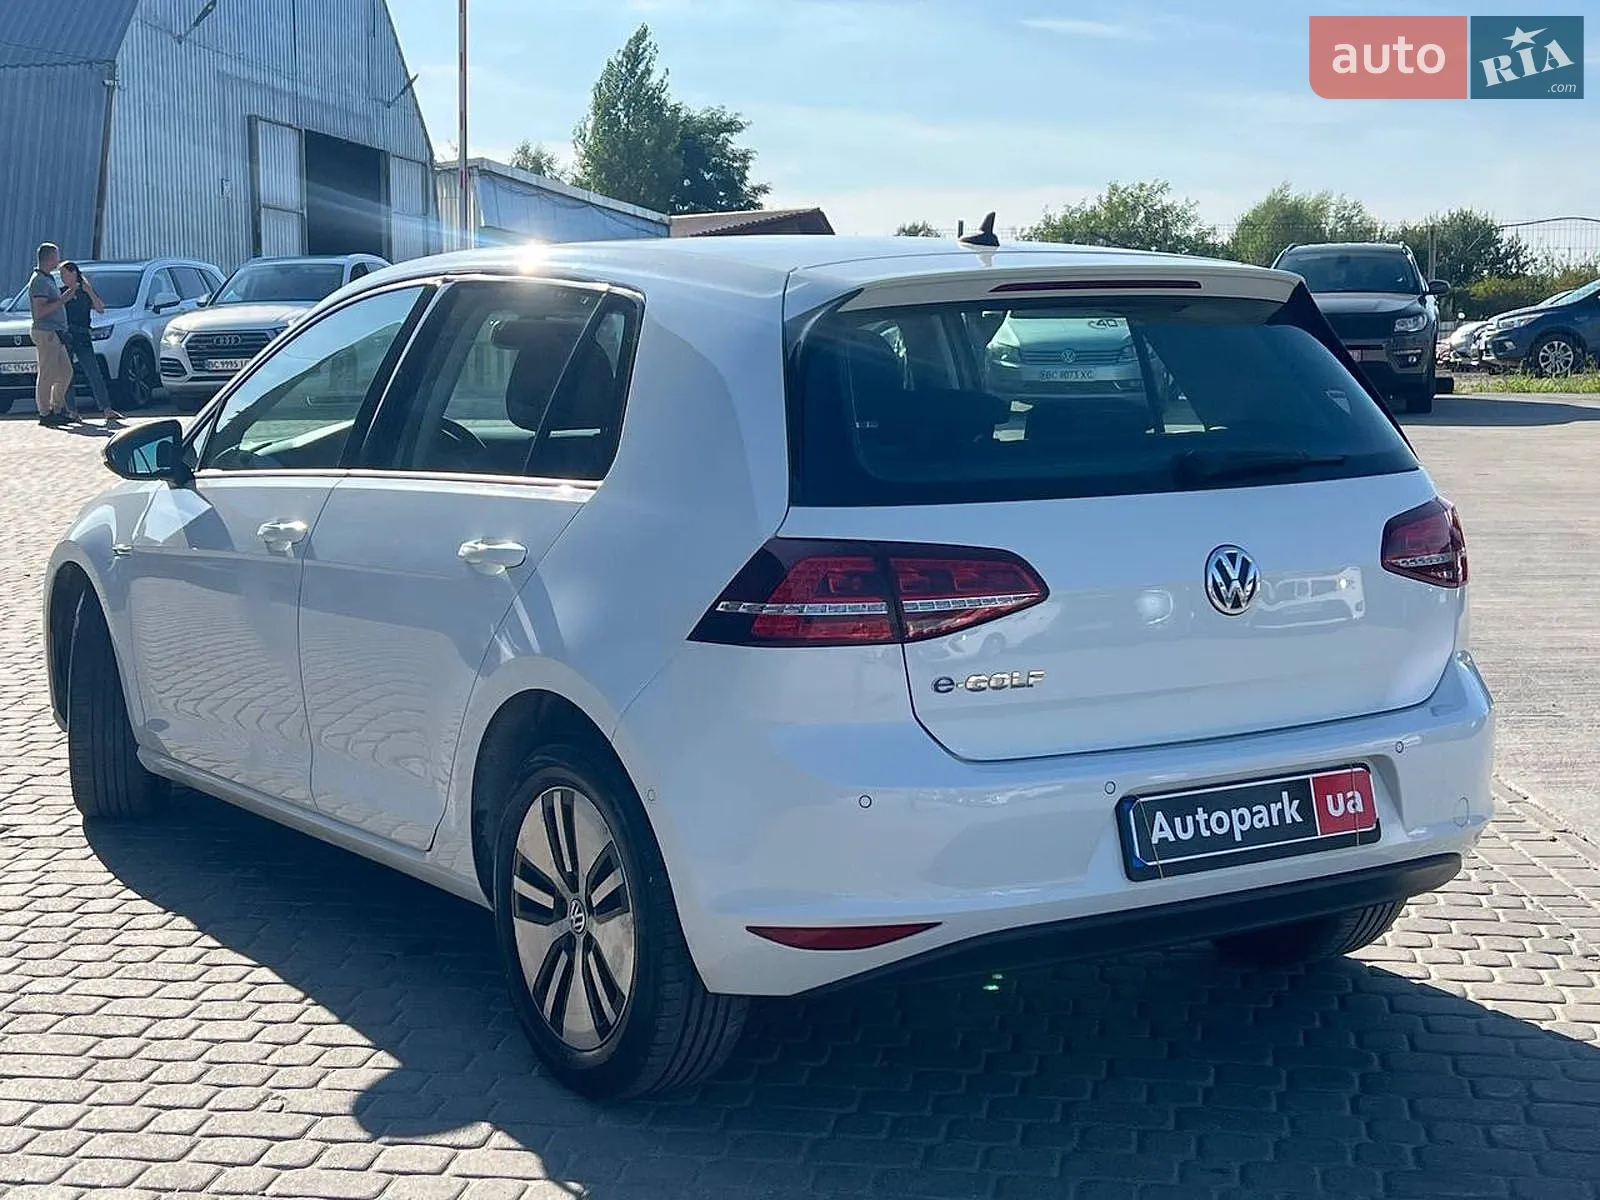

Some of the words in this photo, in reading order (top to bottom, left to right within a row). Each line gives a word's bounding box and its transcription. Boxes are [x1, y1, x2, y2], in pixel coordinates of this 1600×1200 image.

[933, 669, 1045, 693] e-GOLF
[1151, 791, 1303, 845] Autopark
[1326, 790, 1364, 817] ua
